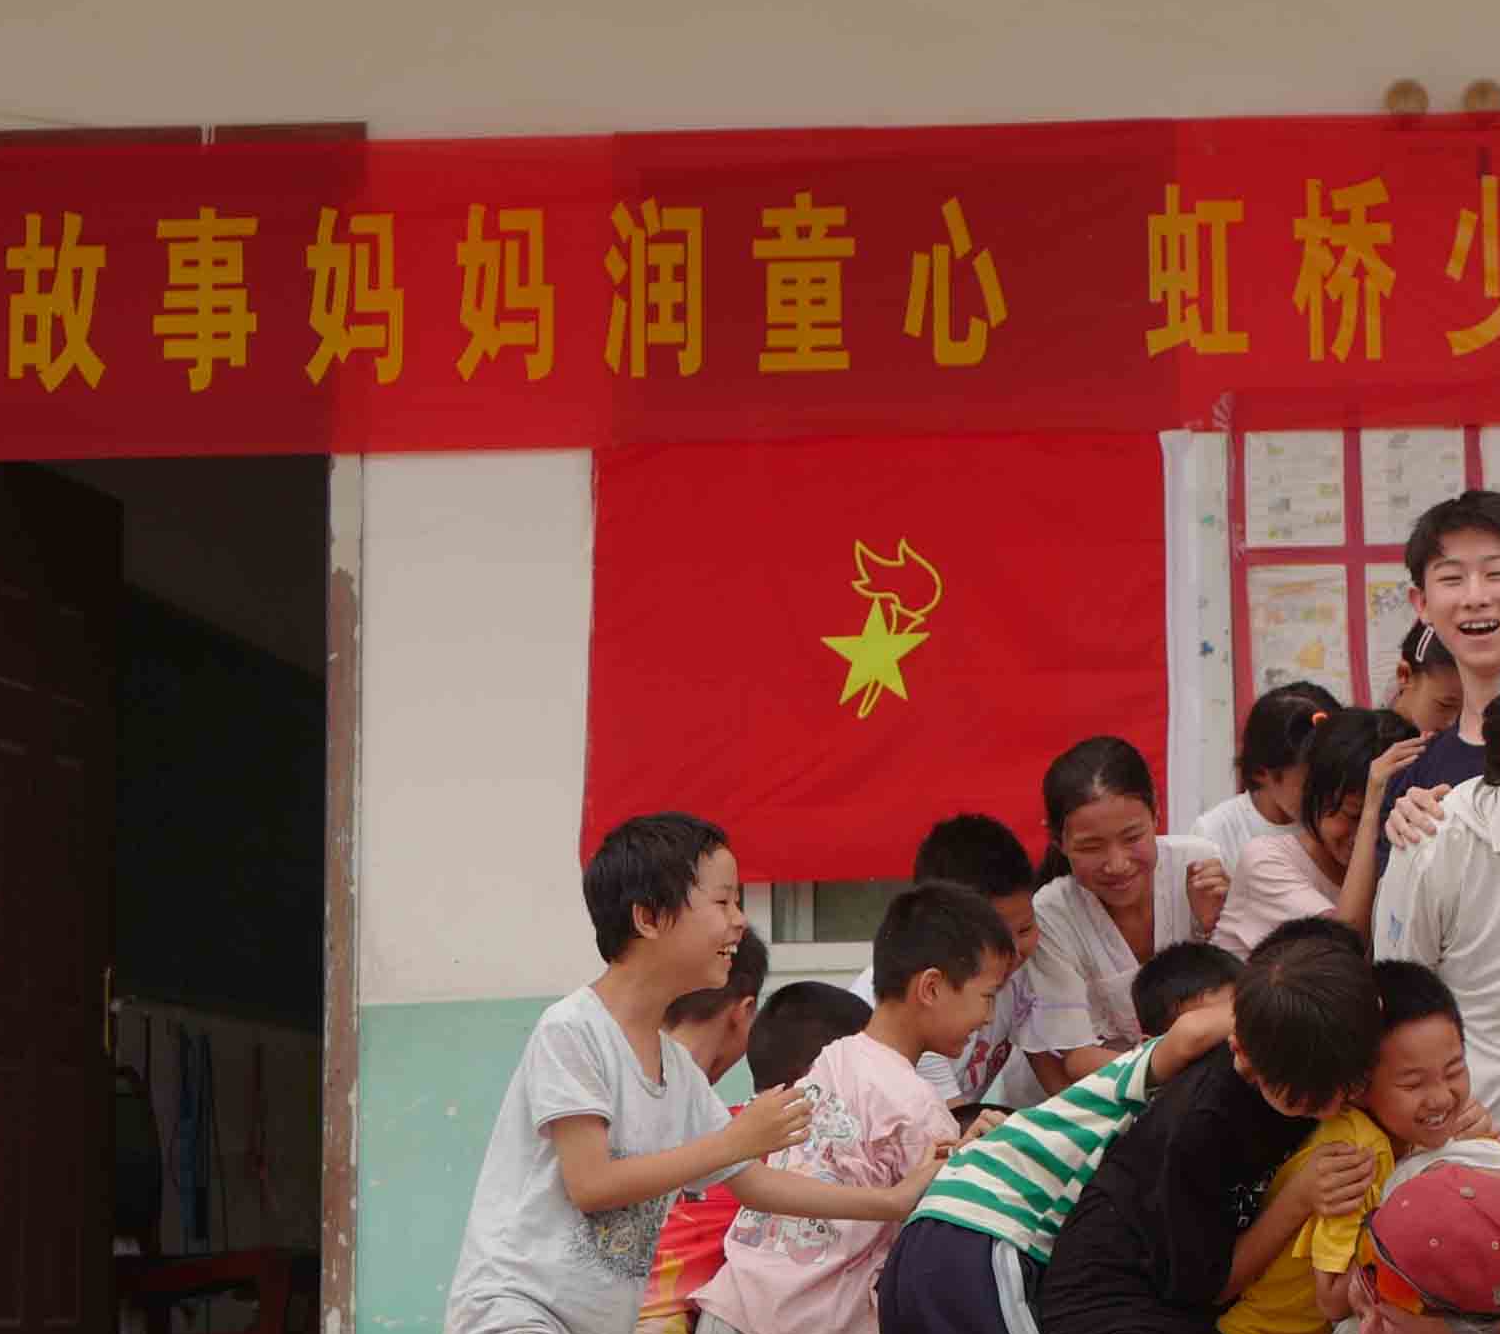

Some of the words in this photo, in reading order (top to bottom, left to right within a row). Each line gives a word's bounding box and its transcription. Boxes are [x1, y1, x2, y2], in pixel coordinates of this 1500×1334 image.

[6, 192, 1009, 395] 故事妈妈润童心
